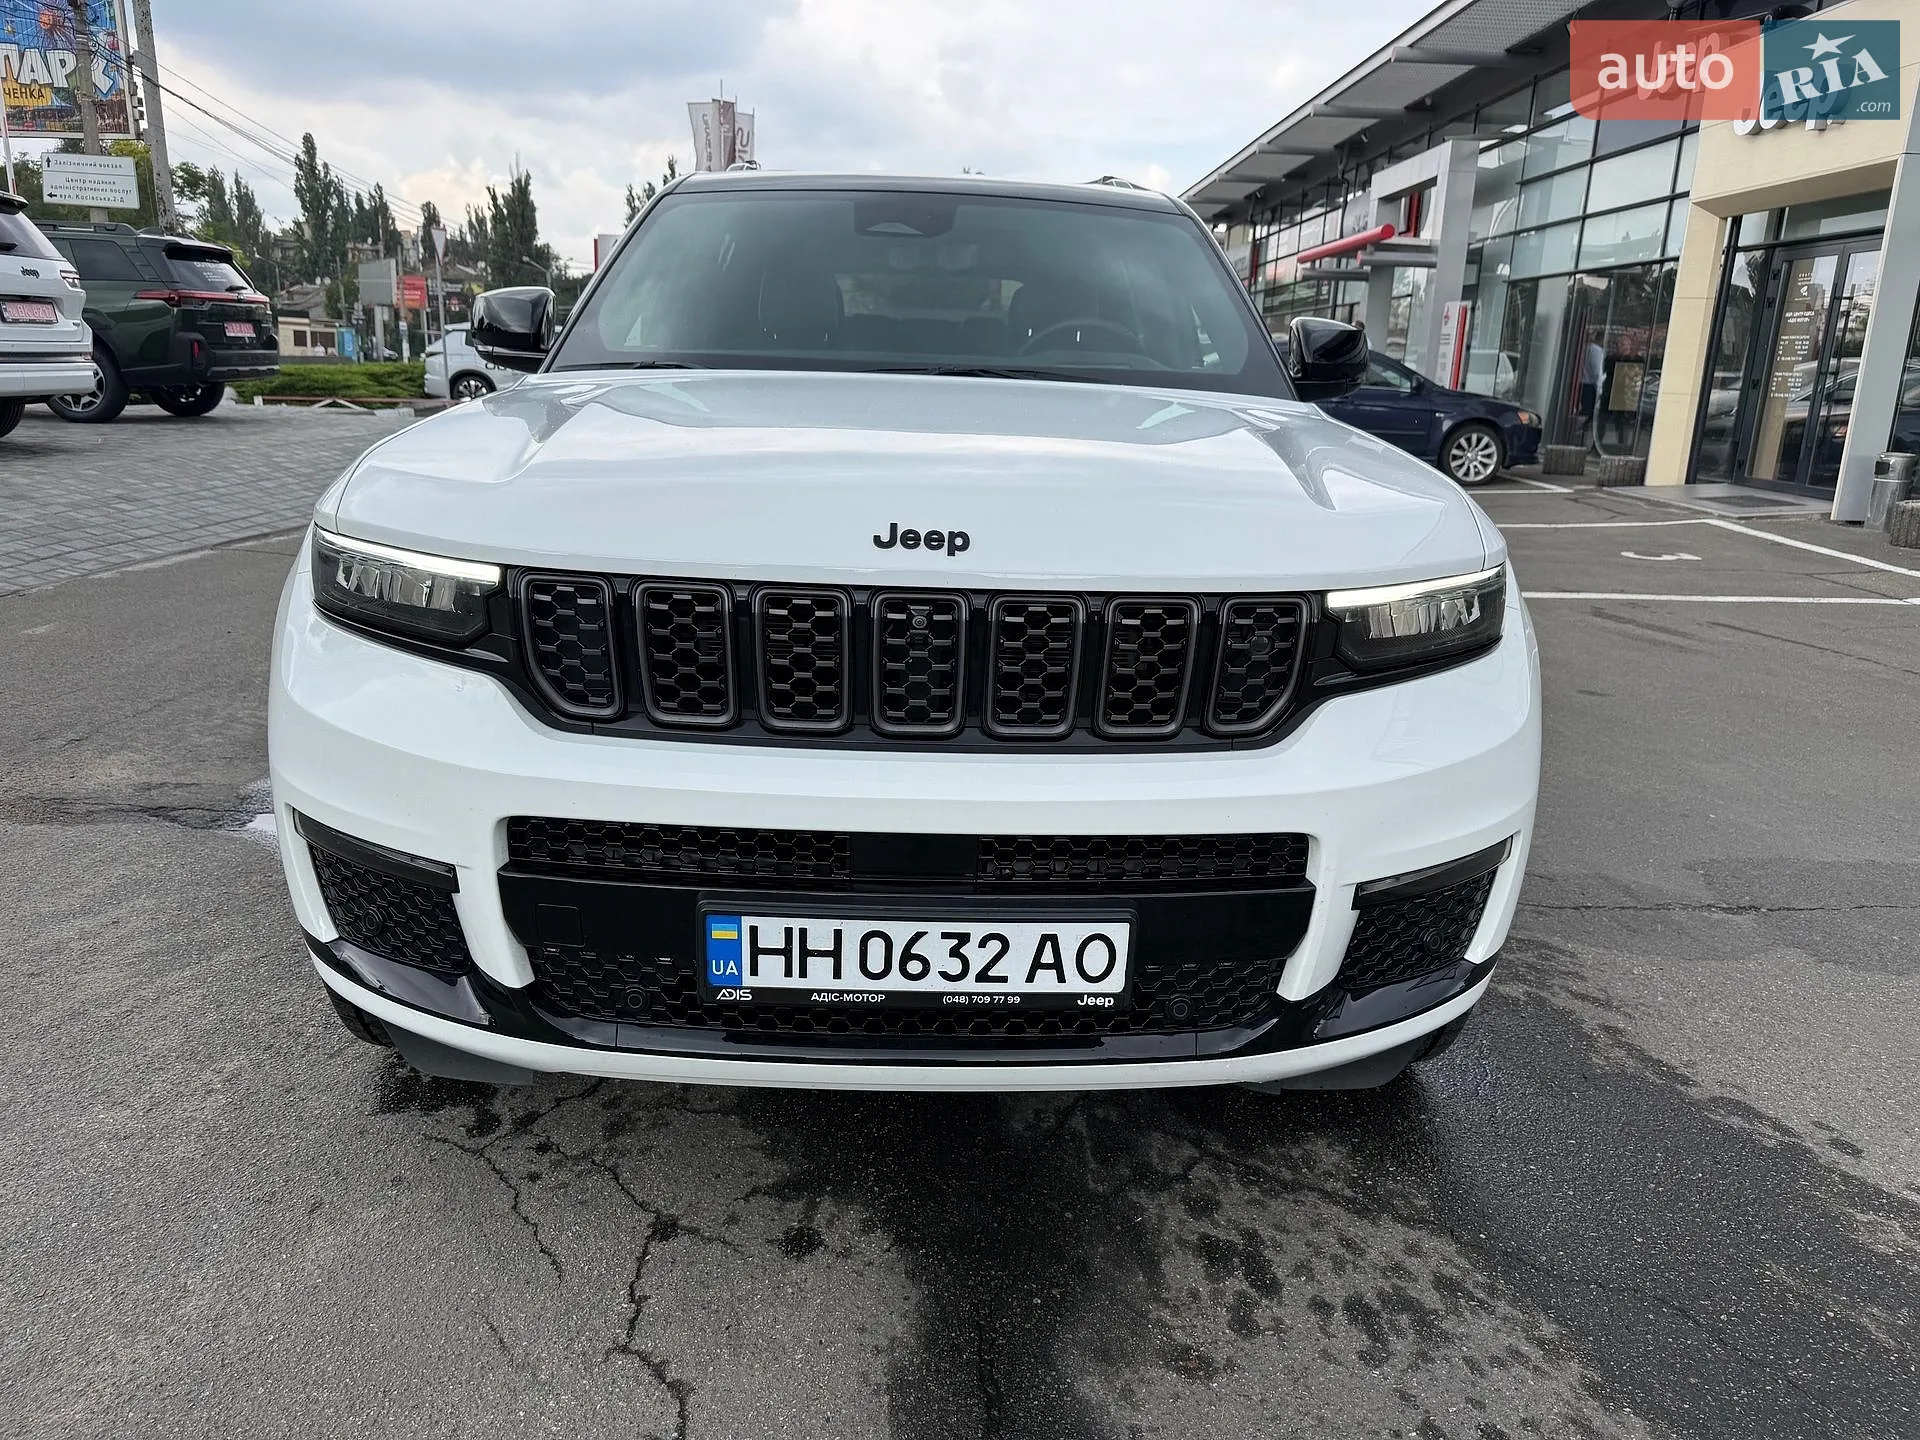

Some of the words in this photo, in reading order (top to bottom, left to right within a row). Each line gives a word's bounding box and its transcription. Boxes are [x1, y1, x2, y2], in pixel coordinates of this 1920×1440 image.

[2, 87, 46, 100] ЧЕНКА
[54, 159, 97, 168] Залізничний
[65, 176, 87, 185] Центр
[873, 522, 970, 557] Jeep
[858, 929, 1010, 984] 0632
[712, 959, 738, 976] UA
[716, 988, 752, 1001] ADIS
[811, 992, 886, 1003] АДІС-МОТОР
[942, 995, 969, 1005] (048)
[971, 996, 992, 1004] 709
[993, 996, 1006, 1005] 77
[1007, 996, 1021, 1005] 99
[1077, 994, 1115, 1007] Jeep
